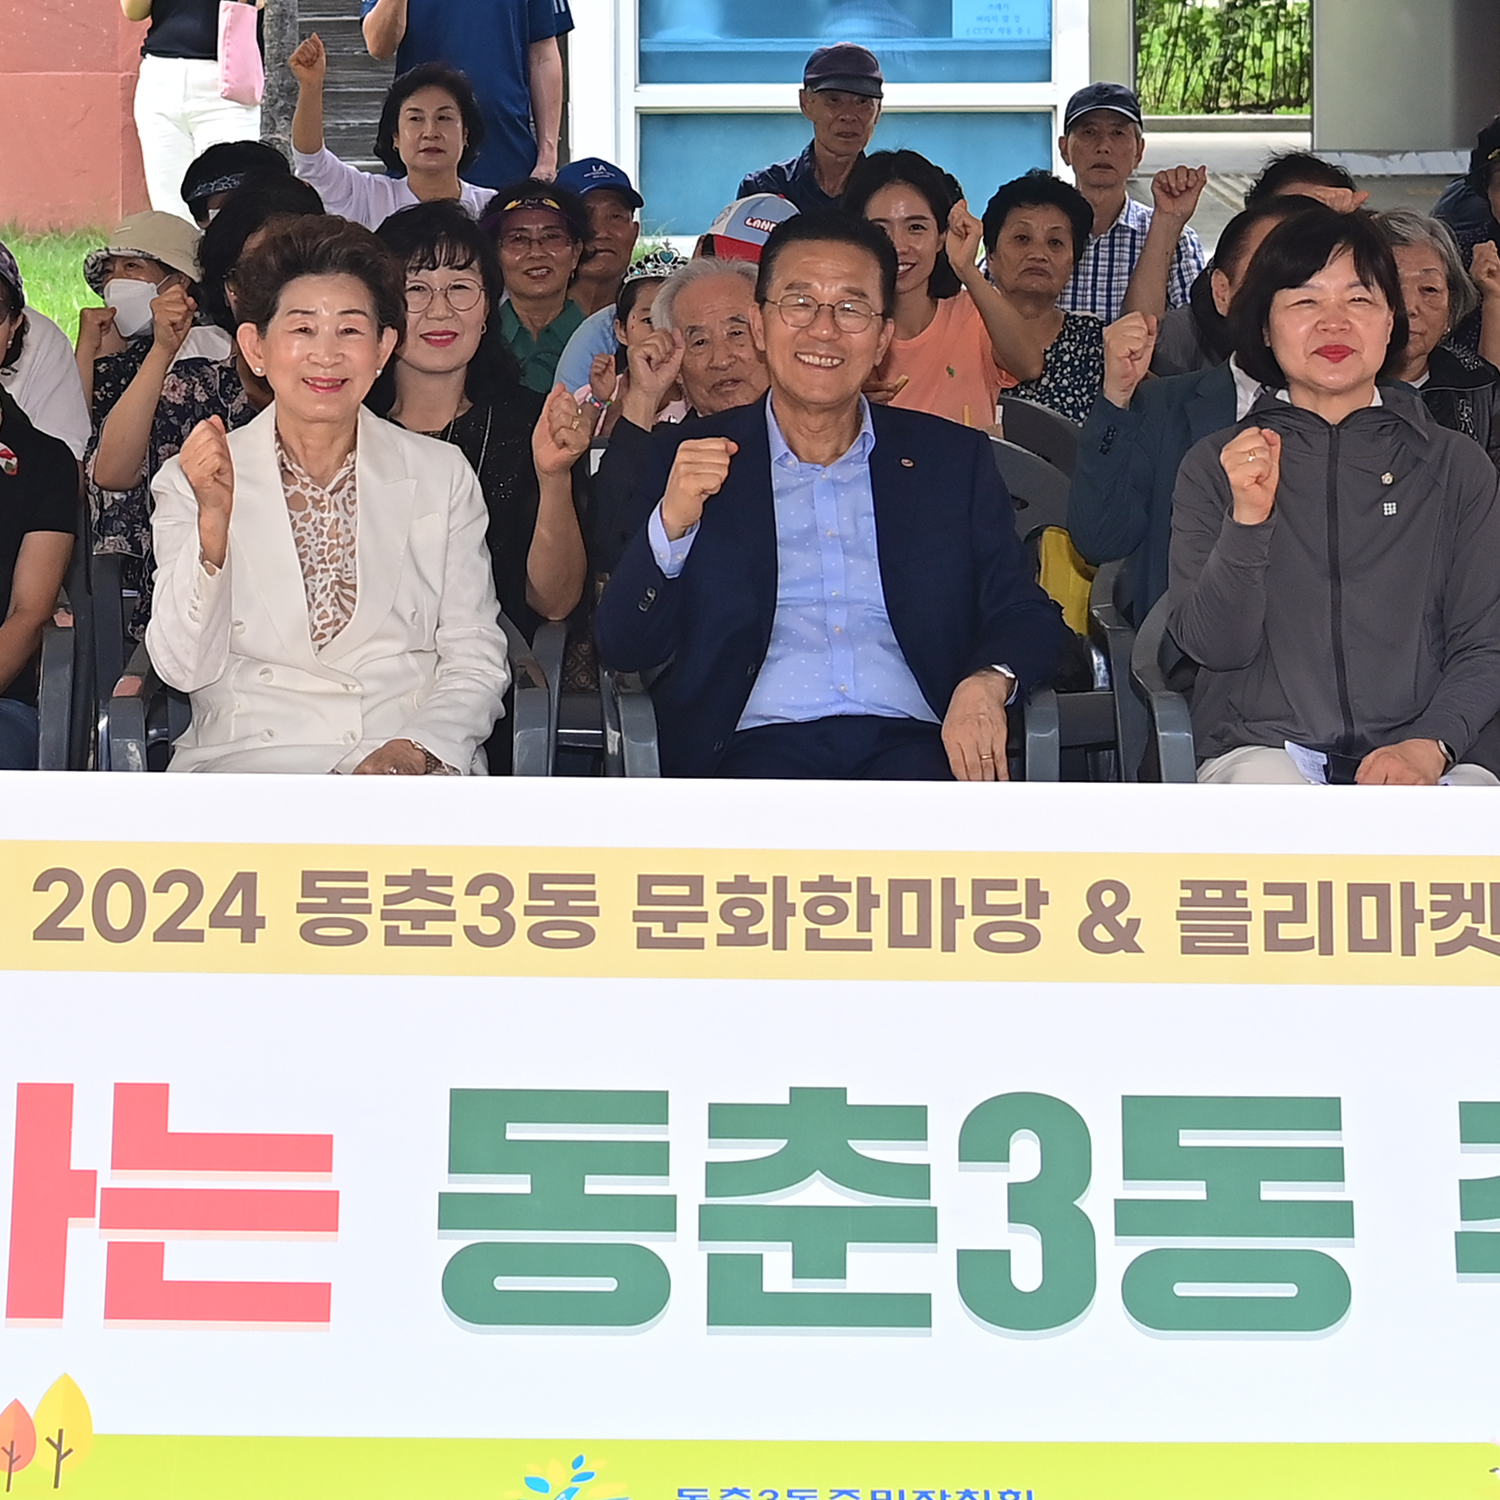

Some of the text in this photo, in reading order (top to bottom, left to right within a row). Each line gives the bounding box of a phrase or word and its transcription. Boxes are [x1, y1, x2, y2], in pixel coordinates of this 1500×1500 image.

[32, 867, 266, 944] 2024
[295, 868, 600, 950] 동춘3동
[632, 873, 1050, 954] 문화한마당
[1077, 879, 1145, 955] &
[438, 1087, 1355, 1332] 동춘3동
